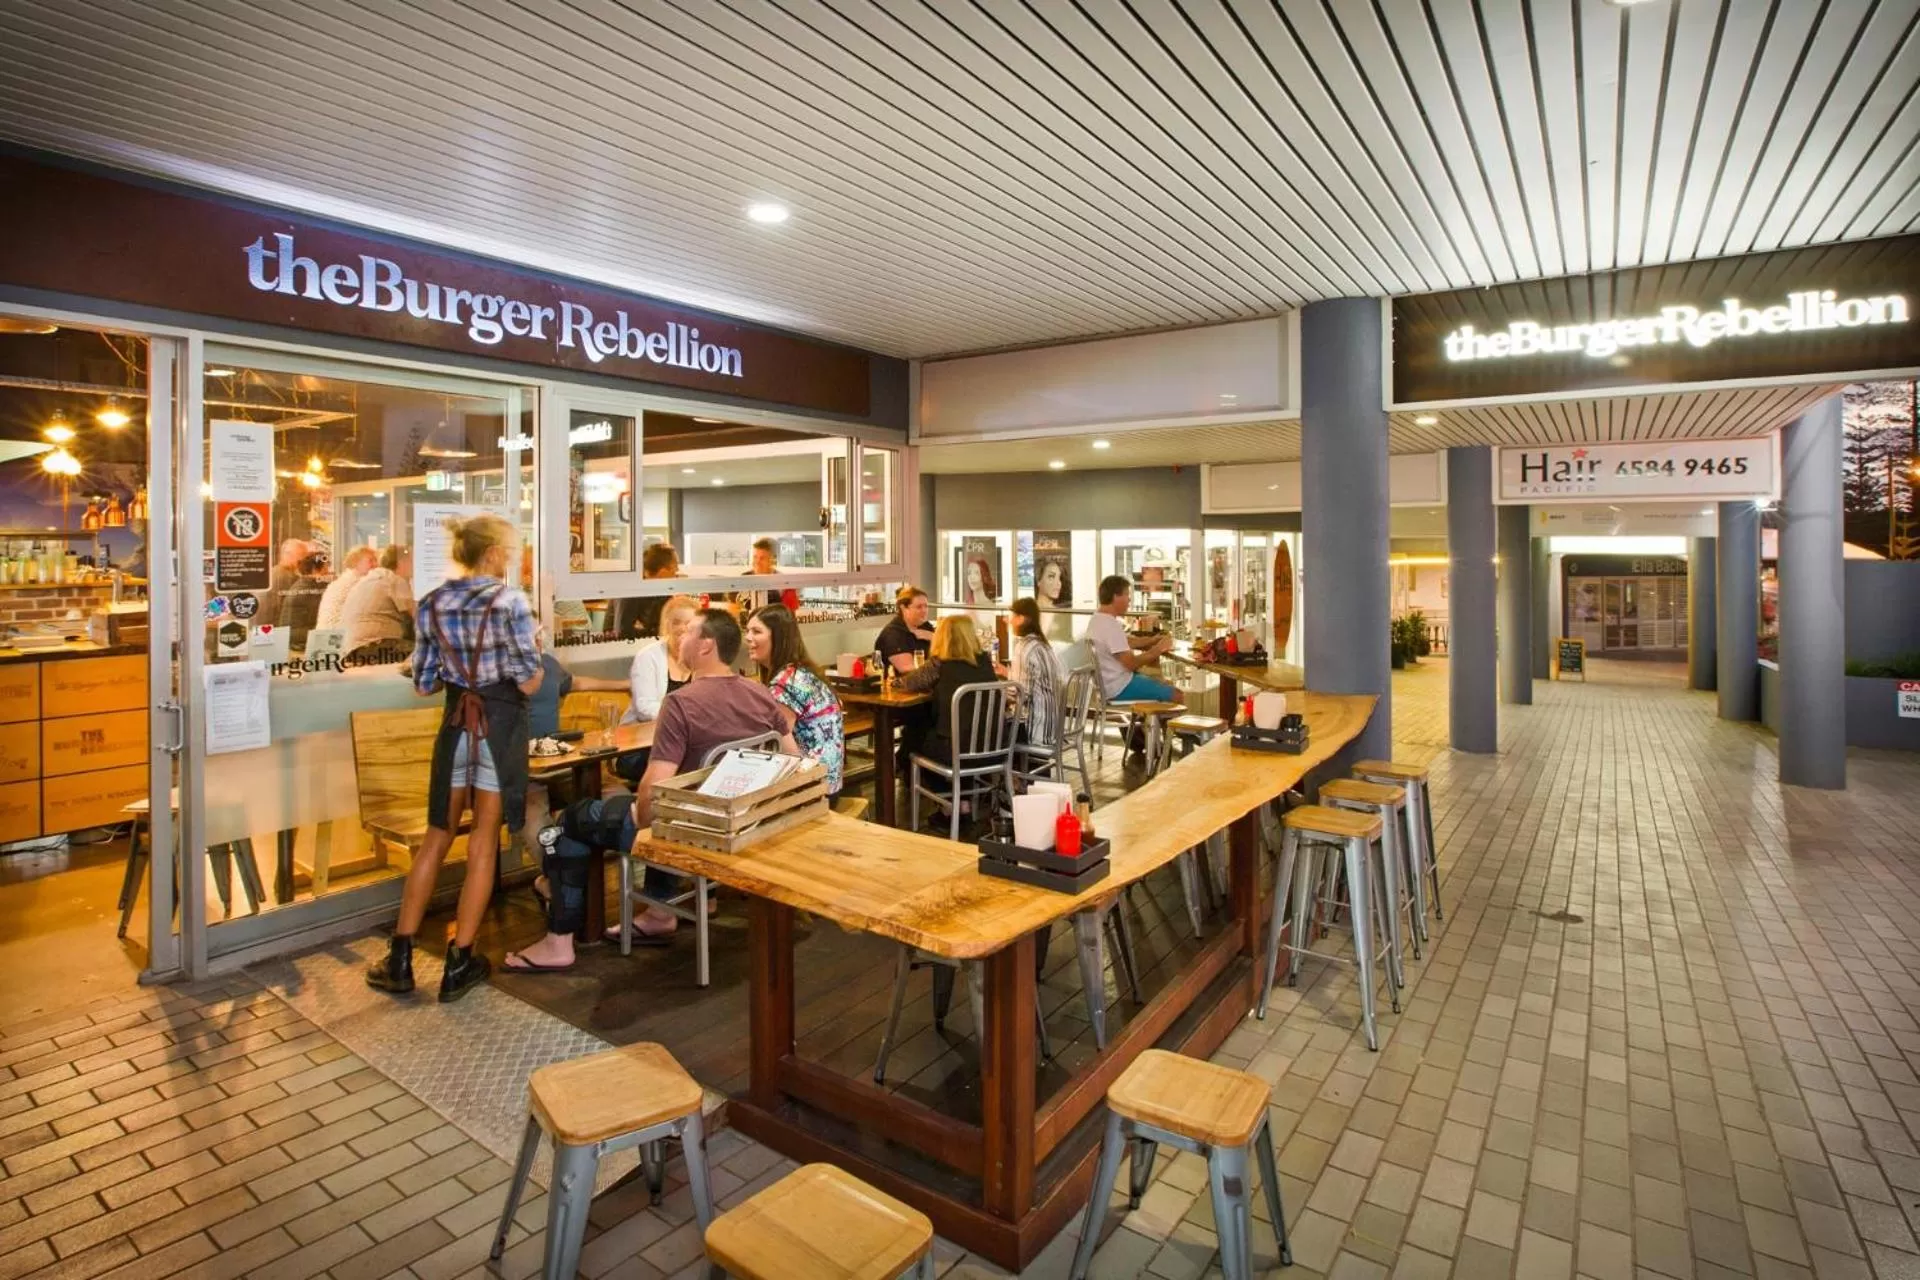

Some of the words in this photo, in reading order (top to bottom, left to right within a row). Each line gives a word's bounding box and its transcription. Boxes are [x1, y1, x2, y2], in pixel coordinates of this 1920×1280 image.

[1520, 449, 1602, 483] Hair
[1614, 458, 1676, 479] 6584
[1684, 456, 1748, 476] 9465
[966, 542, 985, 553] CPR
